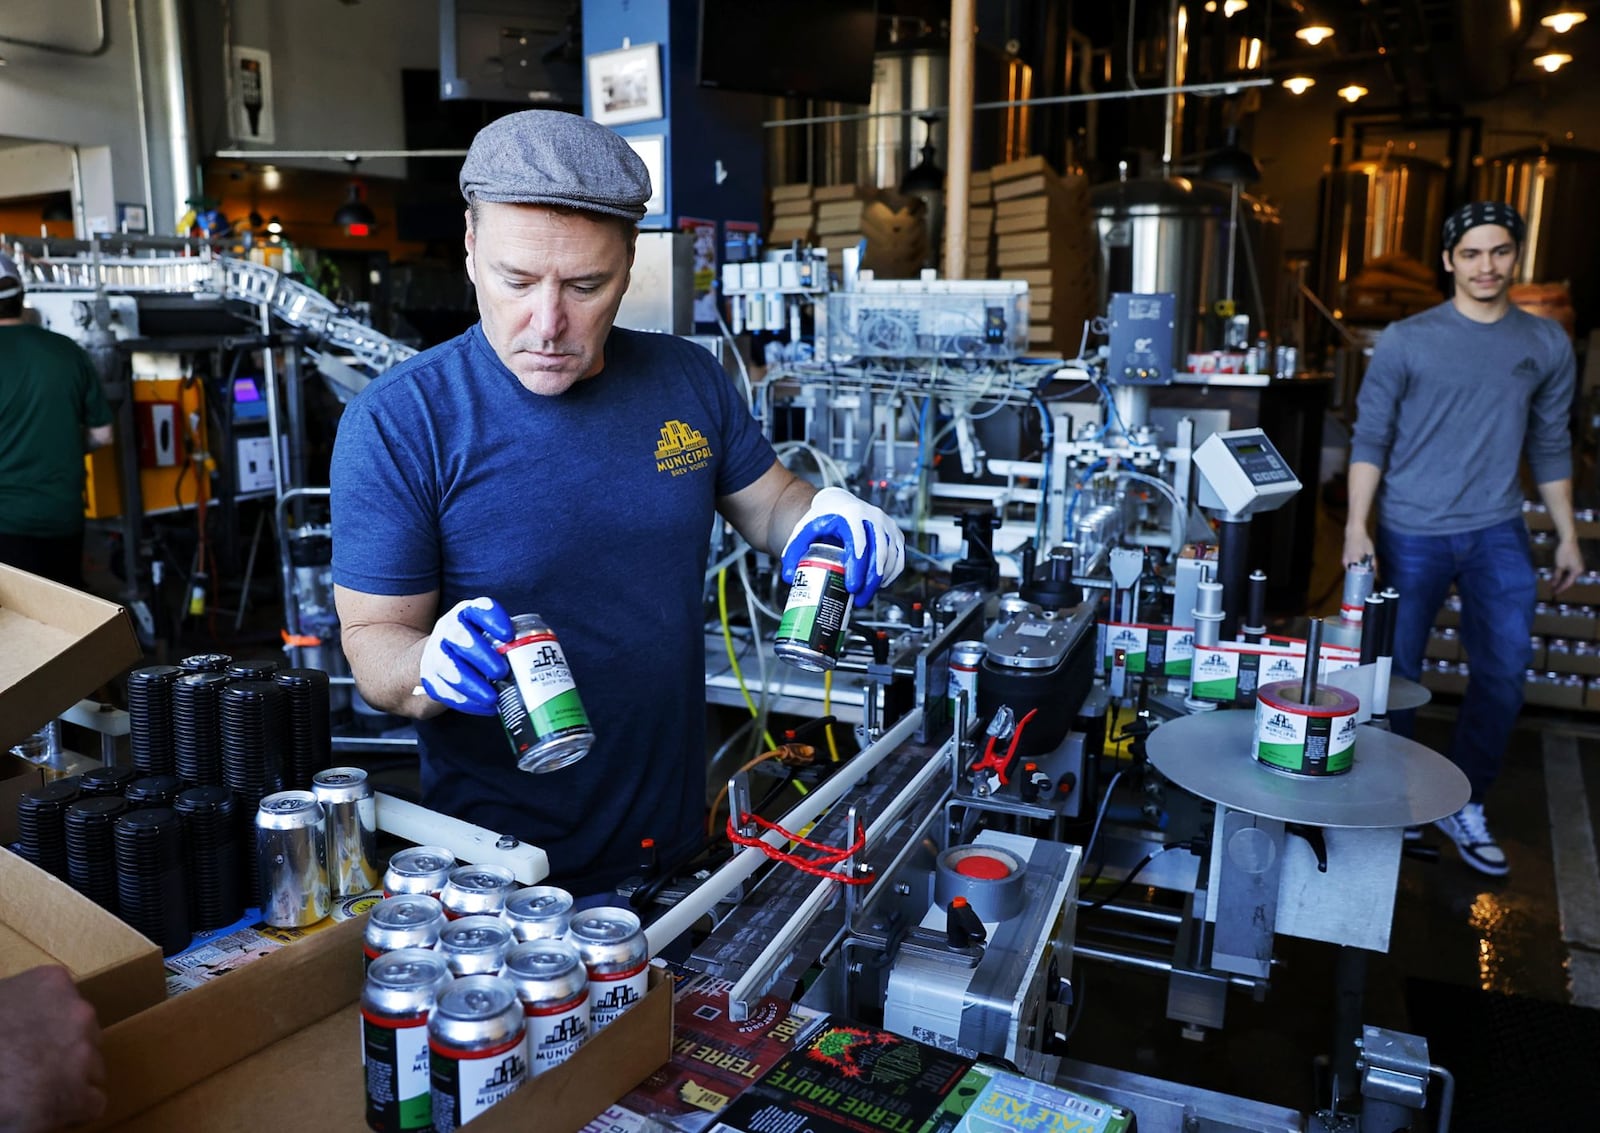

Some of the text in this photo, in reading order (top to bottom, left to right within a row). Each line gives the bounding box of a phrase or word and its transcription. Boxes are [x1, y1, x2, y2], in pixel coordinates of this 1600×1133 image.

[656, 446, 713, 472] MUNICIPAL
[693, 1045, 761, 1079] TERRE
[766, 1071, 838, 1103] HAUTE
[827, 1075, 911, 1114] BREWING
[985, 1092, 1030, 1112] ALE
[838, 1101, 915, 1133] TERRE
